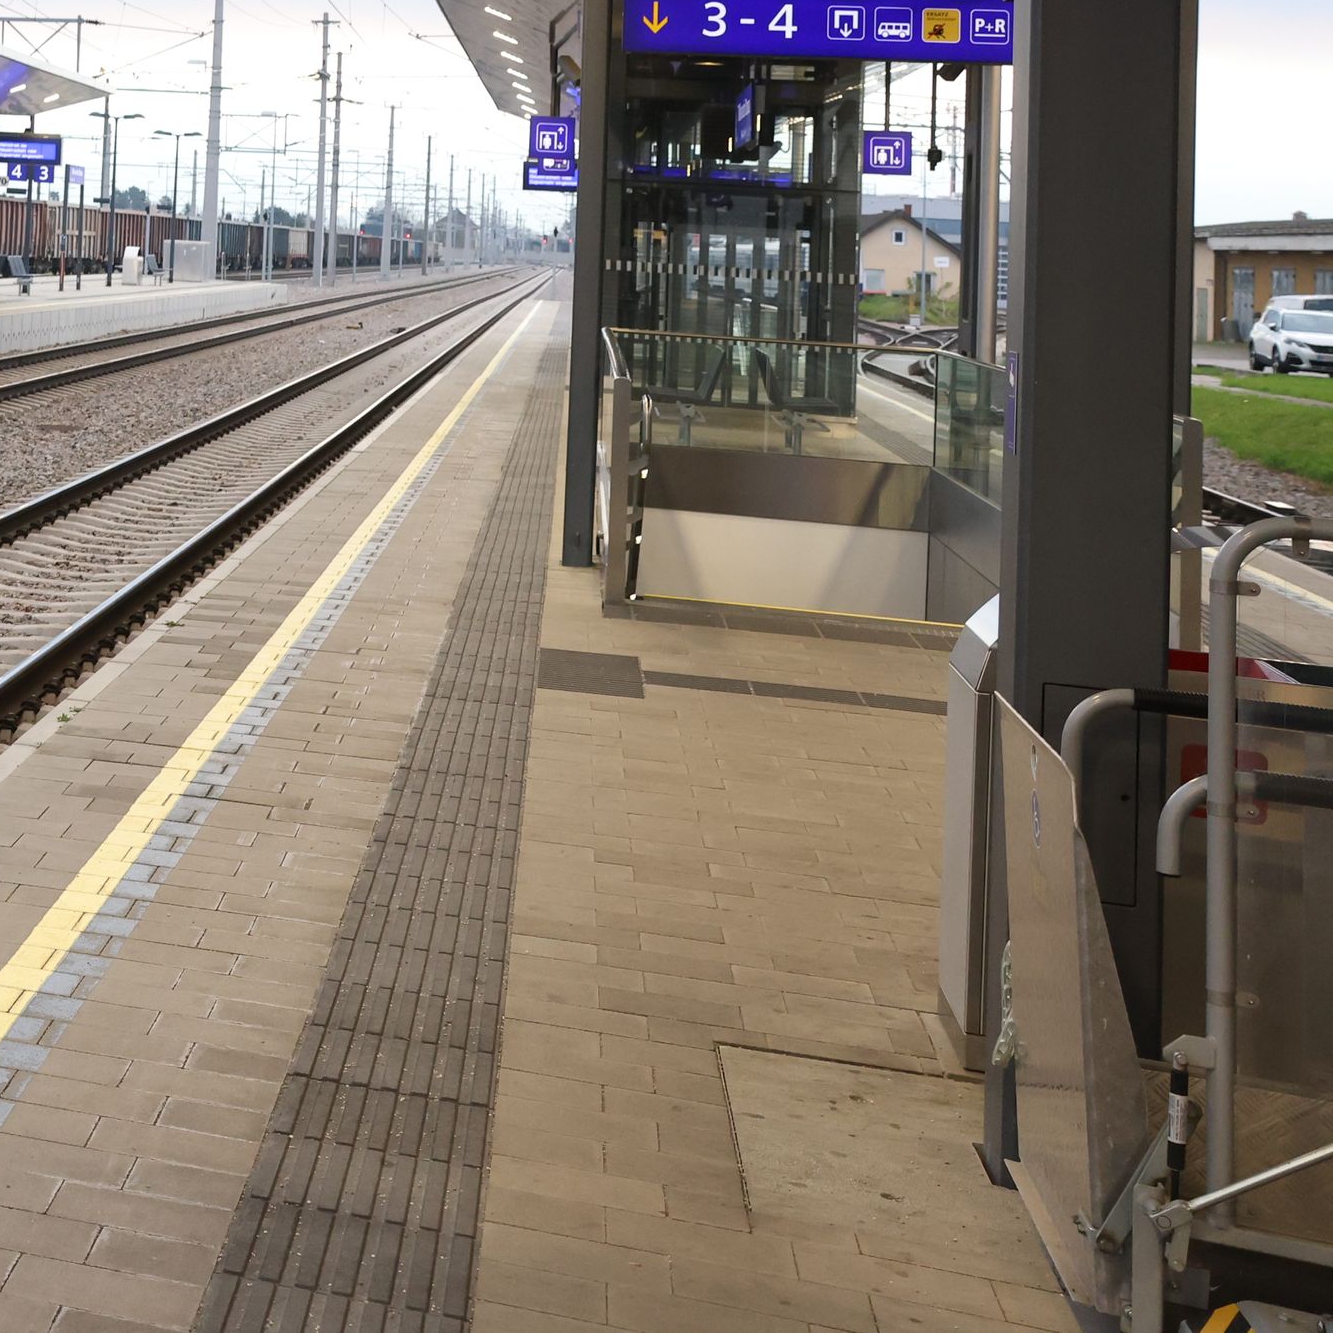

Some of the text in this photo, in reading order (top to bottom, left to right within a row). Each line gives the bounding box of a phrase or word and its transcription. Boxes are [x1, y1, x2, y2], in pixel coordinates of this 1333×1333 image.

[974, 18, 1006, 33] P+R
[11, 164, 22, 178] 4
[39, 166, 49, 180] 3
